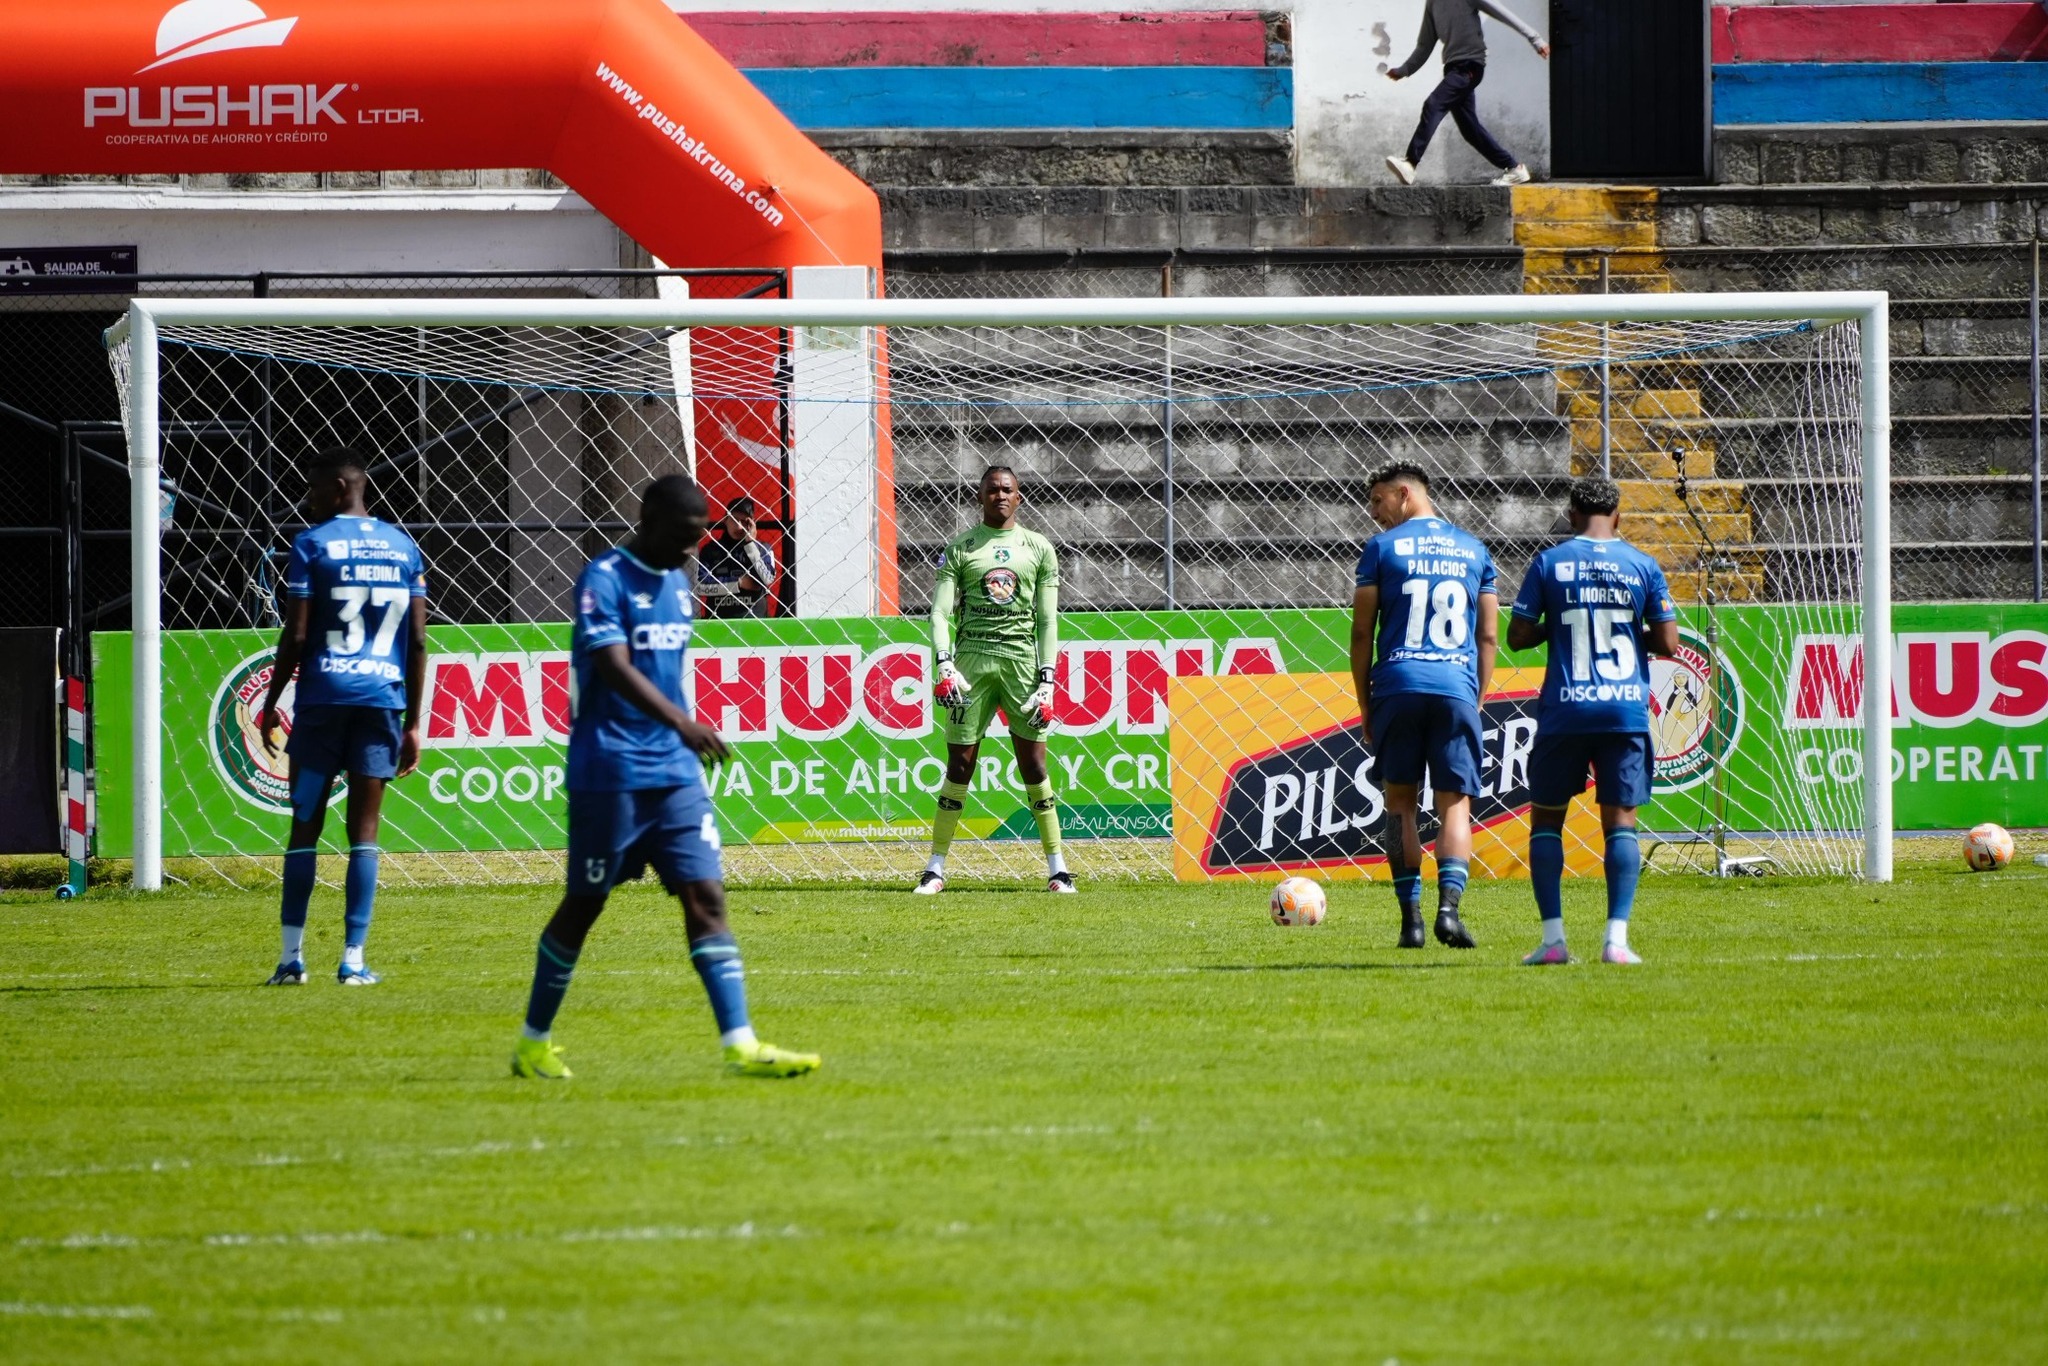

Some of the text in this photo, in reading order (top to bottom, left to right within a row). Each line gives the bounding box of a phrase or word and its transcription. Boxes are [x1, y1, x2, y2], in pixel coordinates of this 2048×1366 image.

[84, 83, 424, 128] PUSHAK LTDA.
[105, 130, 328, 145] COOPERATIVA DE AHORRO Y CRÉDITO
[595, 61, 784, 228] www.pushakruna.com
[44, 262, 101, 273] SALIDA DE
[1417, 535, 1455, 547] BANCO
[351, 550, 409, 562] PICHINCHA
[1417, 545, 1476, 560] PICHINCHA
[341, 565, 400, 582] C. MEDINA
[1408, 560, 1467, 578] PALACIOS
[1579, 561, 1619, 572] BANCO
[1578, 571, 1641, 587] PICHINCHA
[1565, 587, 1631, 605] L. MORENO
[326, 586, 410, 656] 37
[1402, 578, 1468, 650] 18
[1561, 608, 1635, 681] 15
[320, 656, 403, 681] DISCOVER
[426, 652, 924, 739] MHUC
[1560, 684, 1642, 702] DISCOVER
[950, 706, 966, 725] 42
[1796, 745, 2048, 784] COPERAT
[770, 759, 825, 797] DE
[845, 756, 1026, 795] AHOR
[1058, 754, 1086, 790] Y
[1258, 717, 1538, 851] PILSER
